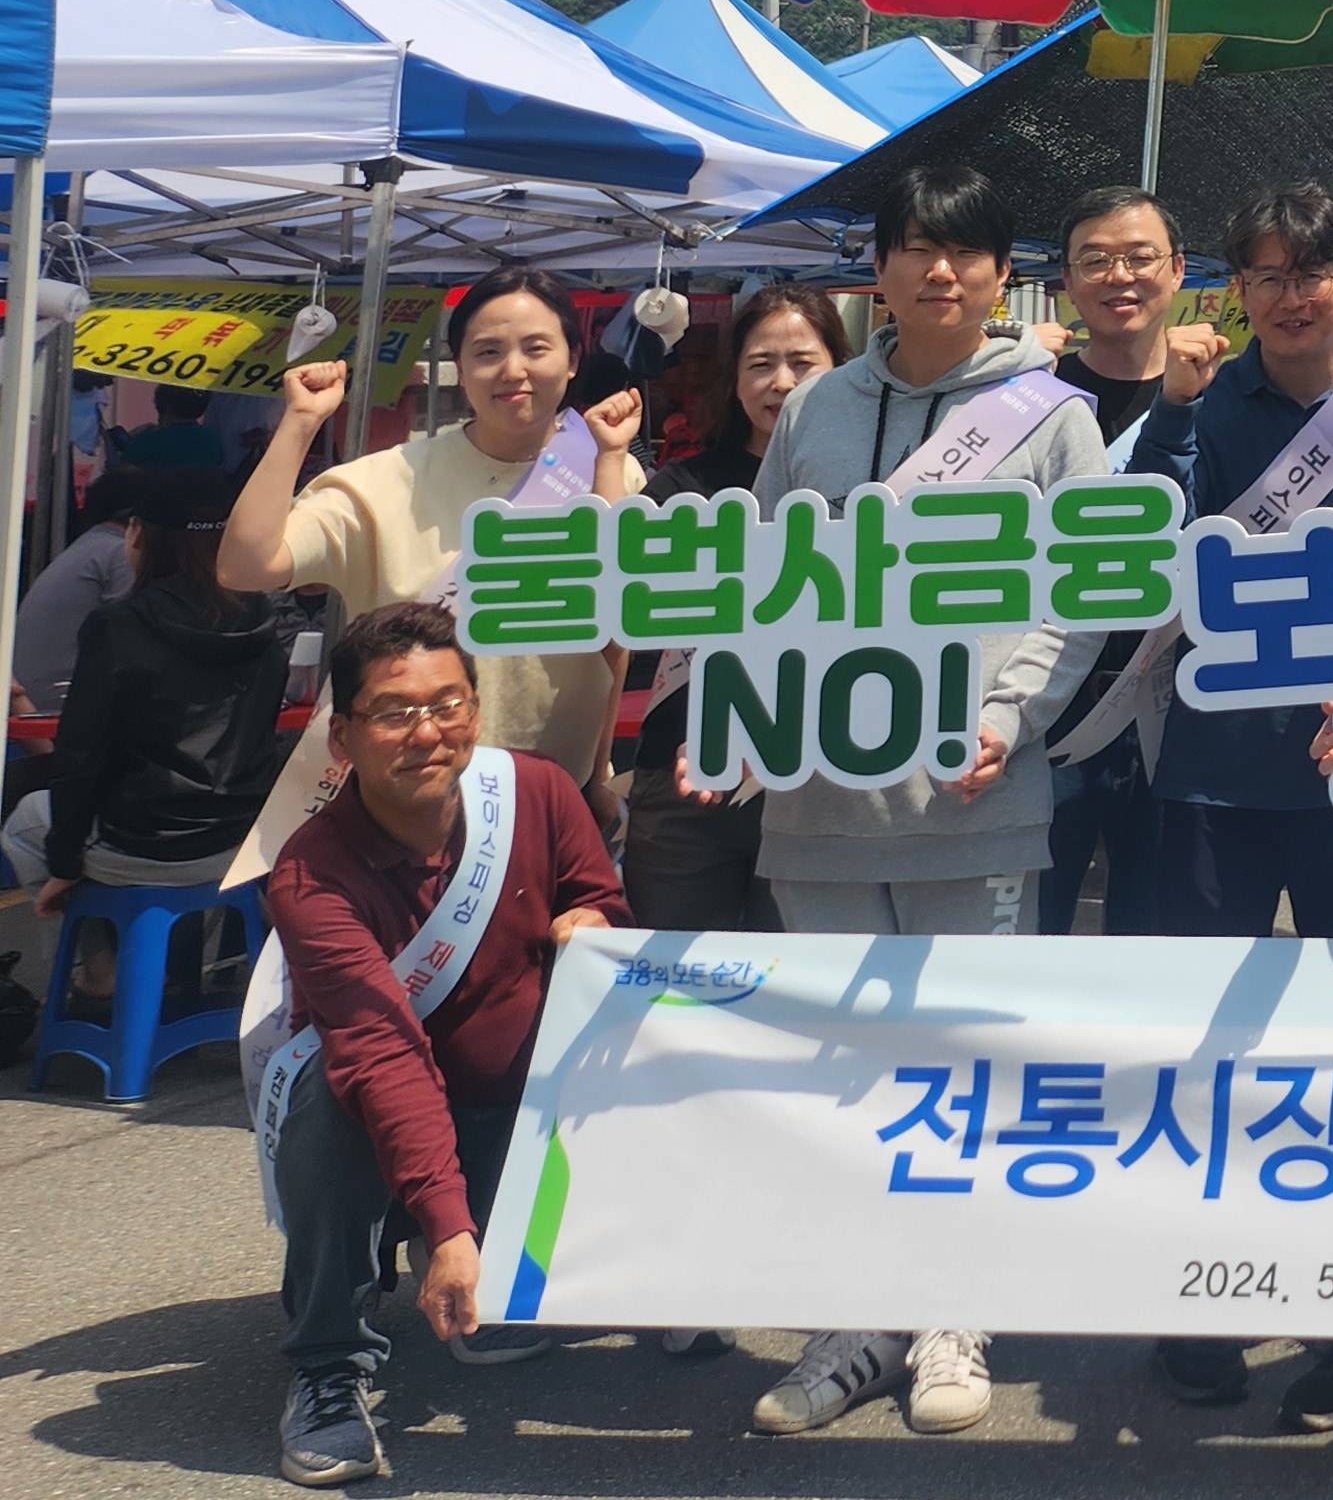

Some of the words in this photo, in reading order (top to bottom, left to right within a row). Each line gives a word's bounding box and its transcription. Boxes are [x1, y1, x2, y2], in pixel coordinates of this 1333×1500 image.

[465, 484, 1177, 645] 불법사금융
[699, 641, 970, 778] NO!
[455, 771, 502, 926] 보이스피싱
[614, 958, 669, 987] 금융의
[671, 961, 707, 987] 모든
[711, 960, 753, 988] 순간
[1179, 1258, 1290, 1304] 2024.
